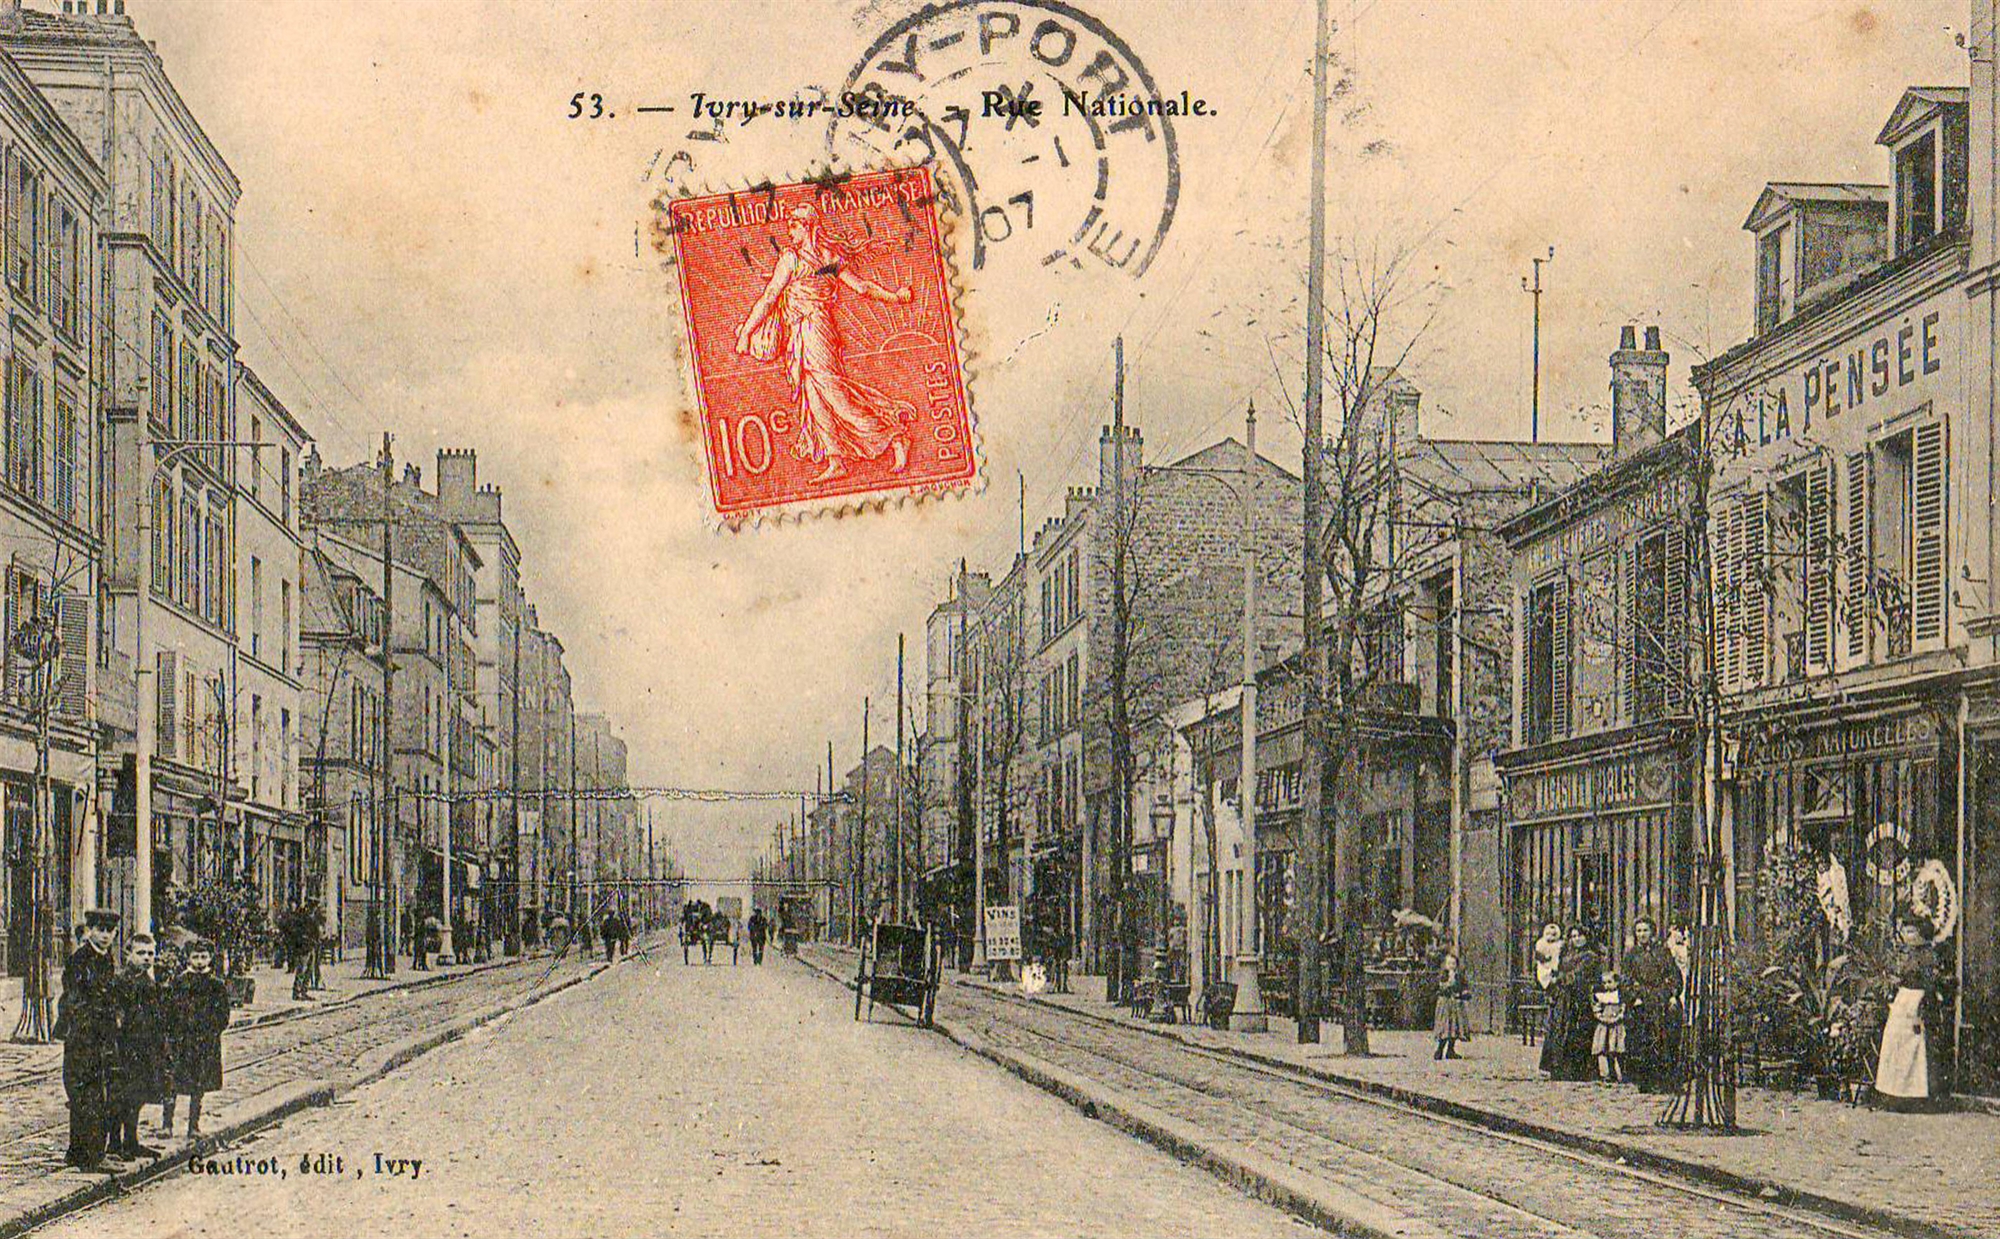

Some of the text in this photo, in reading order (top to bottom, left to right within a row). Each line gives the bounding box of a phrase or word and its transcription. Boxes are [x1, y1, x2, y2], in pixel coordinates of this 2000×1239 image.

[848, 10, 1156, 152] RY-PORT
[925, 361, 958, 460] POSTES
[1758, 387, 1791, 448] LA
